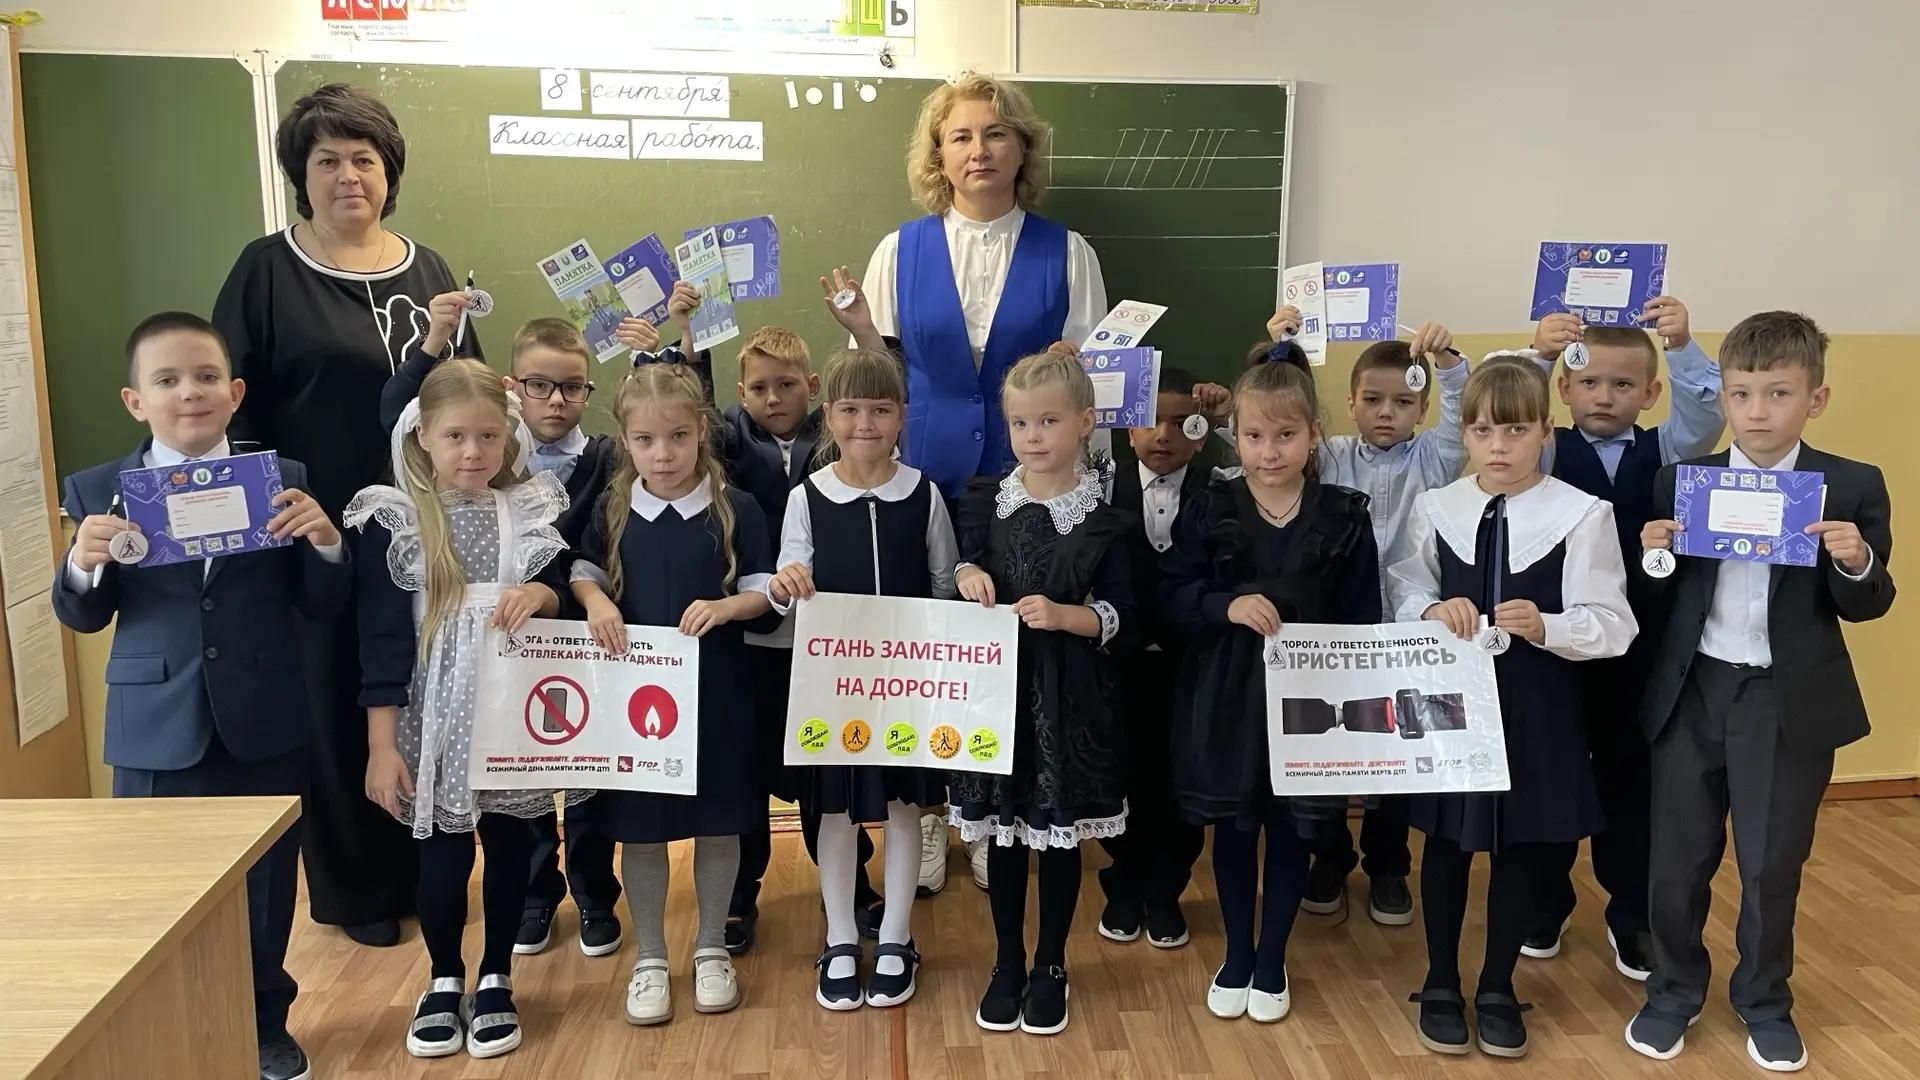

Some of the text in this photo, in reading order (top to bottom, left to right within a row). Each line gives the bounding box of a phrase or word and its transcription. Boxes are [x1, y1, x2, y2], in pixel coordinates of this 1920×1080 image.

[548, 73, 568, 100] 8
[492, 121, 628, 148] Классная
[554, 261, 594, 287] ПАМЯТКА
[1330, 637, 1439, 650] ОТВЕТСТВЕННОСТЬ
[521, 647, 600, 661] ОТВЛЕКАЙСЯ
[807, 637, 1002, 666] СТАНЬ ЗАМЕТНЕЙ
[836, 677, 968, 701] НА ДОРОГЕ!
[804, 726, 813, 736] Я
[890, 730, 899, 740] Я
[973, 734, 982, 744] Я
[486, 764, 527, 772] ВСЕМИРНЫЙ
[637, 760, 658, 768] STOP
[1438, 759, 1462, 767] STOP
[1393, 768, 1407, 776] ДТП
